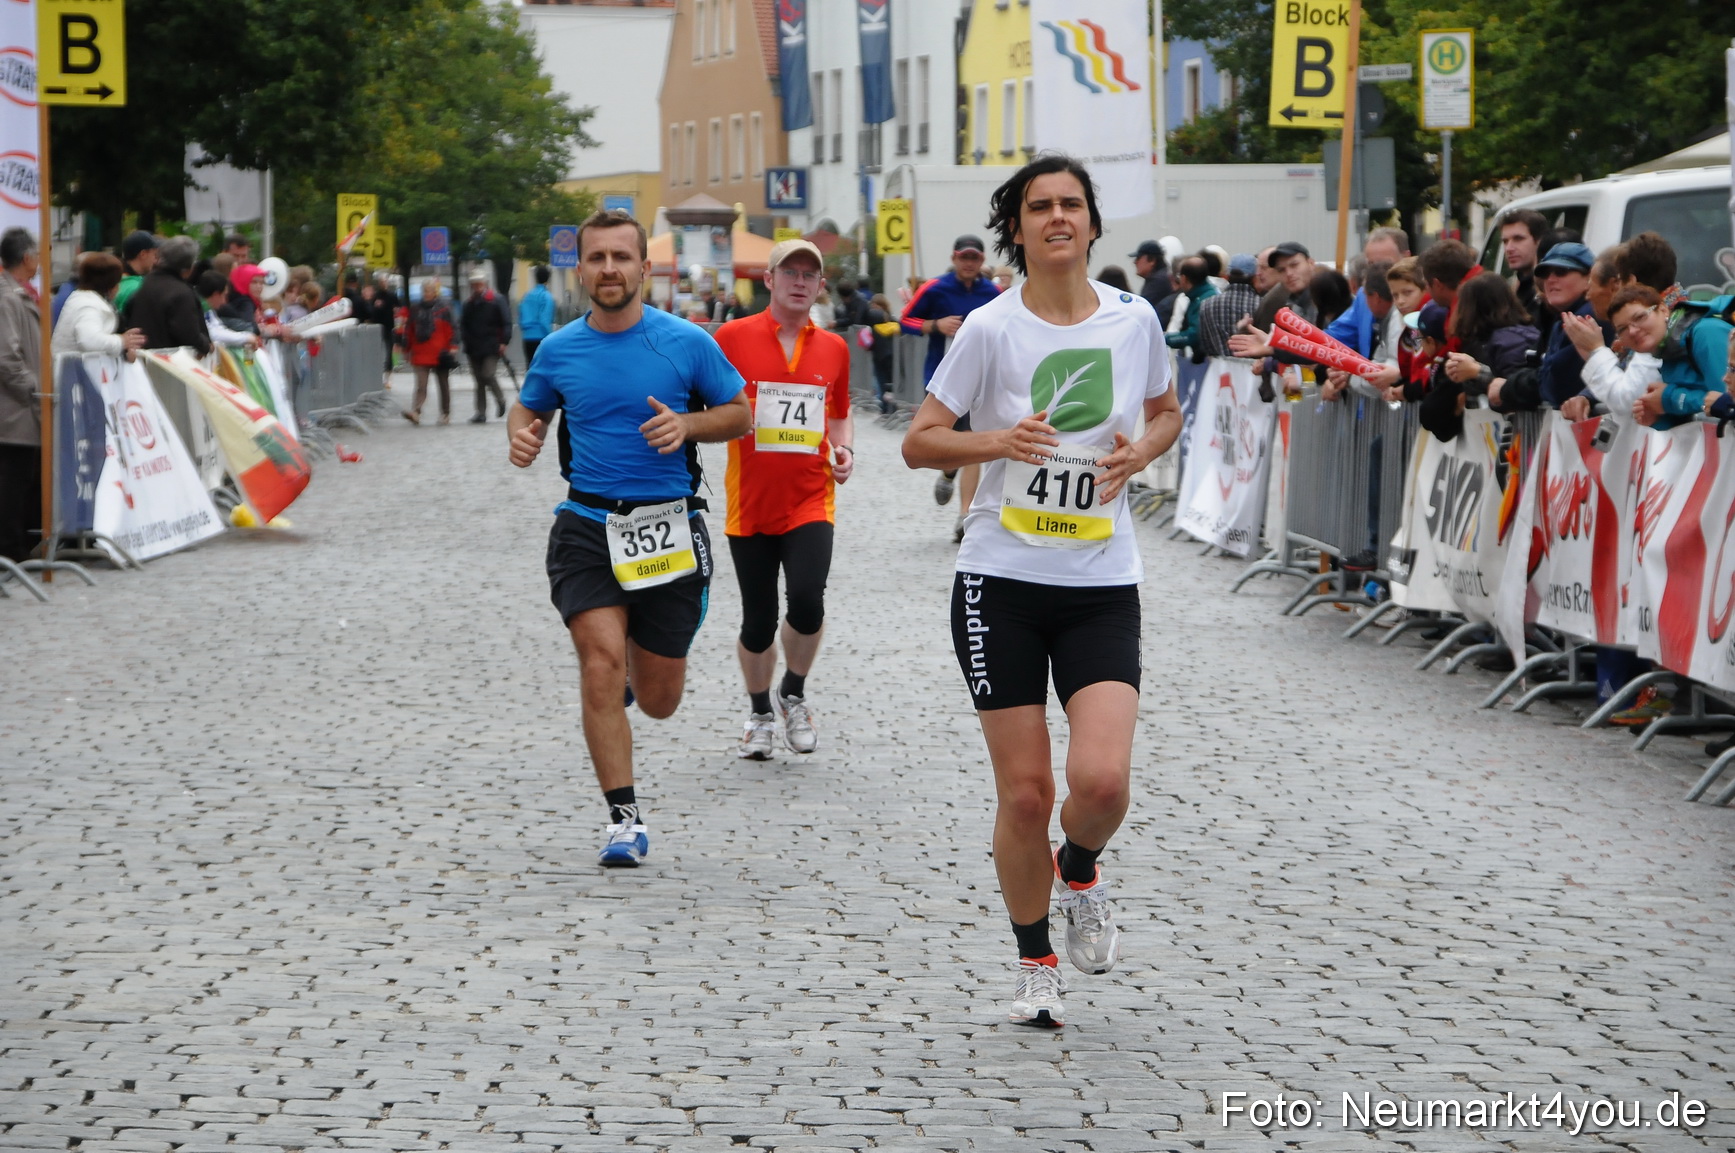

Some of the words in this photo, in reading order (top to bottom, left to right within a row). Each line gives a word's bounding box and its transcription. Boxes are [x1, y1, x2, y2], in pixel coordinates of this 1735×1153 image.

[1286, 2, 1350, 26] Block
[60, 14, 101, 74] B
[1009, 41, 1031, 67] HOTE
[1438, 46, 1455, 65] H
[1294, 36, 1335, 97] B
[881, 202, 909, 211] Block
[886, 216, 904, 242] C
[1278, 335, 1314, 354] Audi
[1316, 348, 1344, 367] BKK
[758, 389, 780, 397] PARTL
[782, 390, 815, 399] Neumarkt
[778, 400, 807, 425] 74
[779, 431, 805, 442] Klaus
[1050, 453, 1099, 467] Neumark
[1026, 467, 1096, 510] 410
[607, 519, 634, 529] PARTL
[1036, 516, 1077, 534] Liane
[621, 521, 675, 557] 352
[636, 559, 670, 576] daniel
[963, 574, 992, 696] Sinupret
